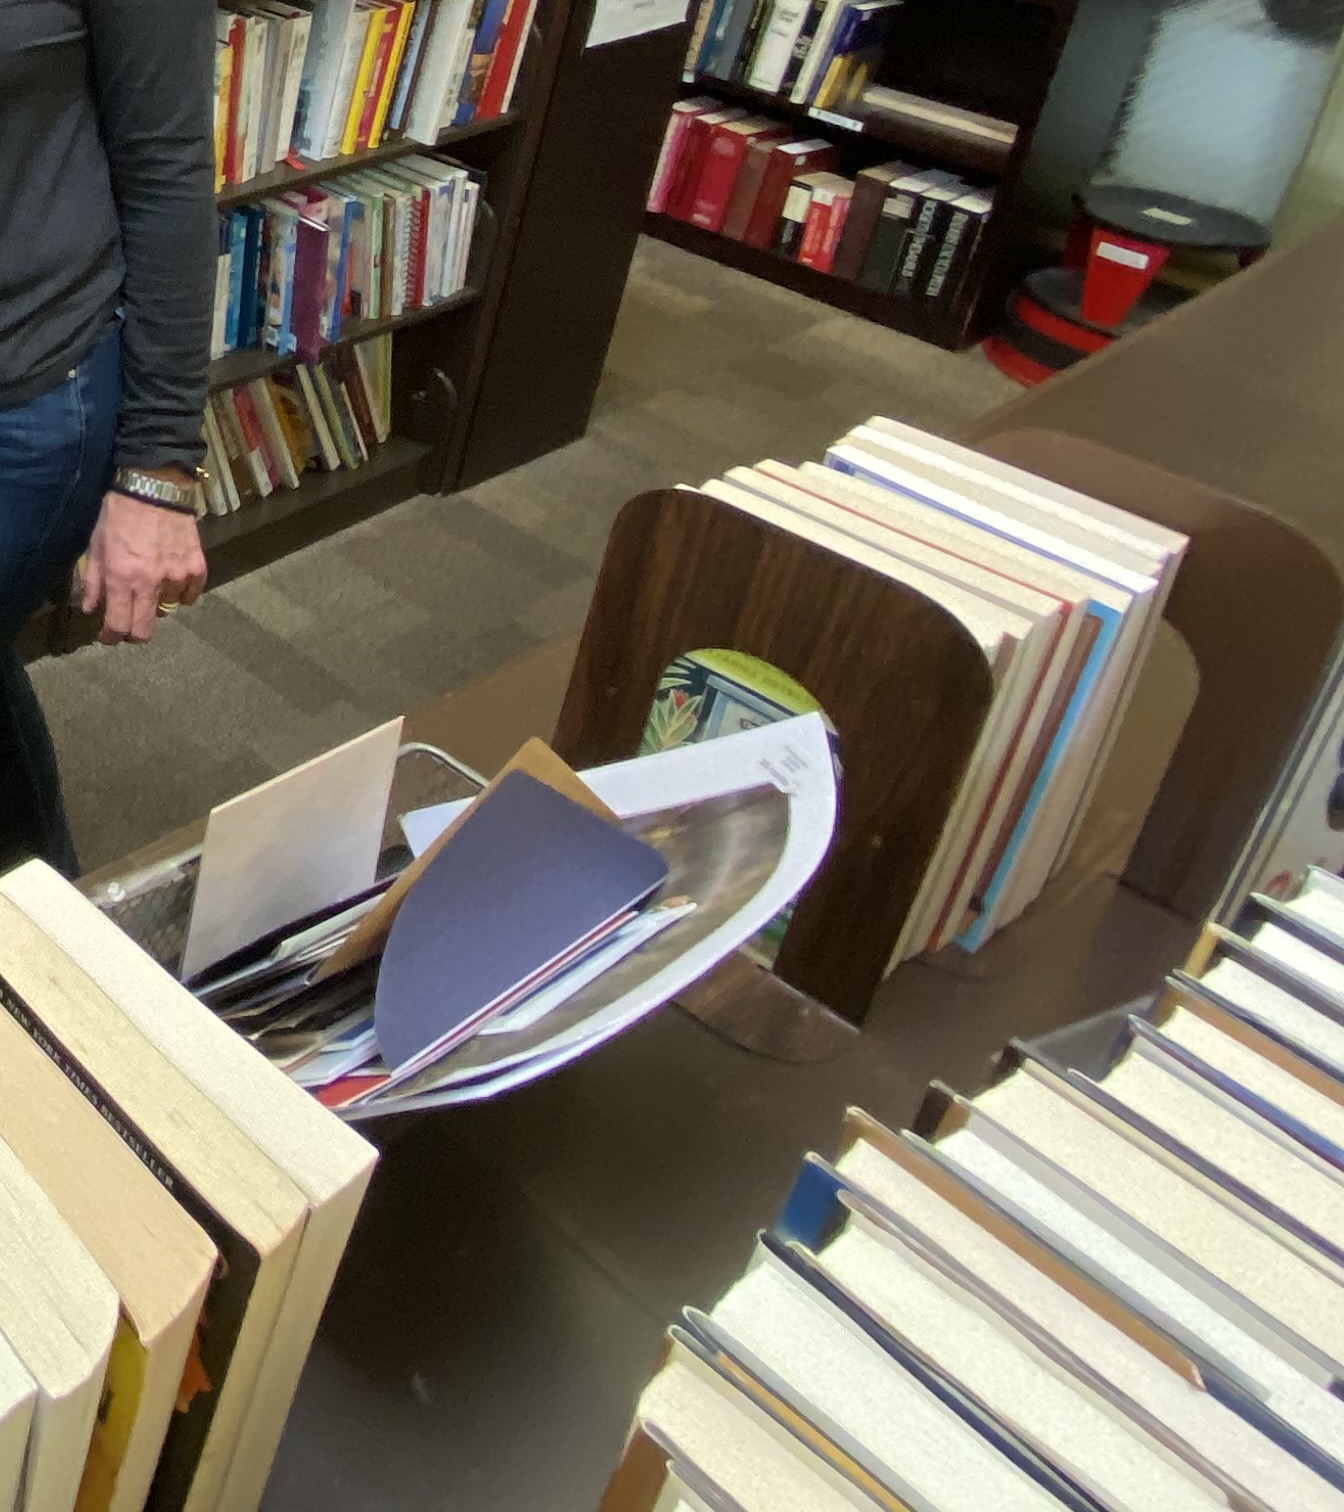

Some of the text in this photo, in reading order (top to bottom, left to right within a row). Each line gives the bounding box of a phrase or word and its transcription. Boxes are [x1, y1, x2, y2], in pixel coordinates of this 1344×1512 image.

[6, 998, 30, 1027] NEW
[32, 1027, 62, 1064] YORK
[65, 1064, 99, 1106] TIMES
[100, 1104, 174, 1190] BESTSELLER
